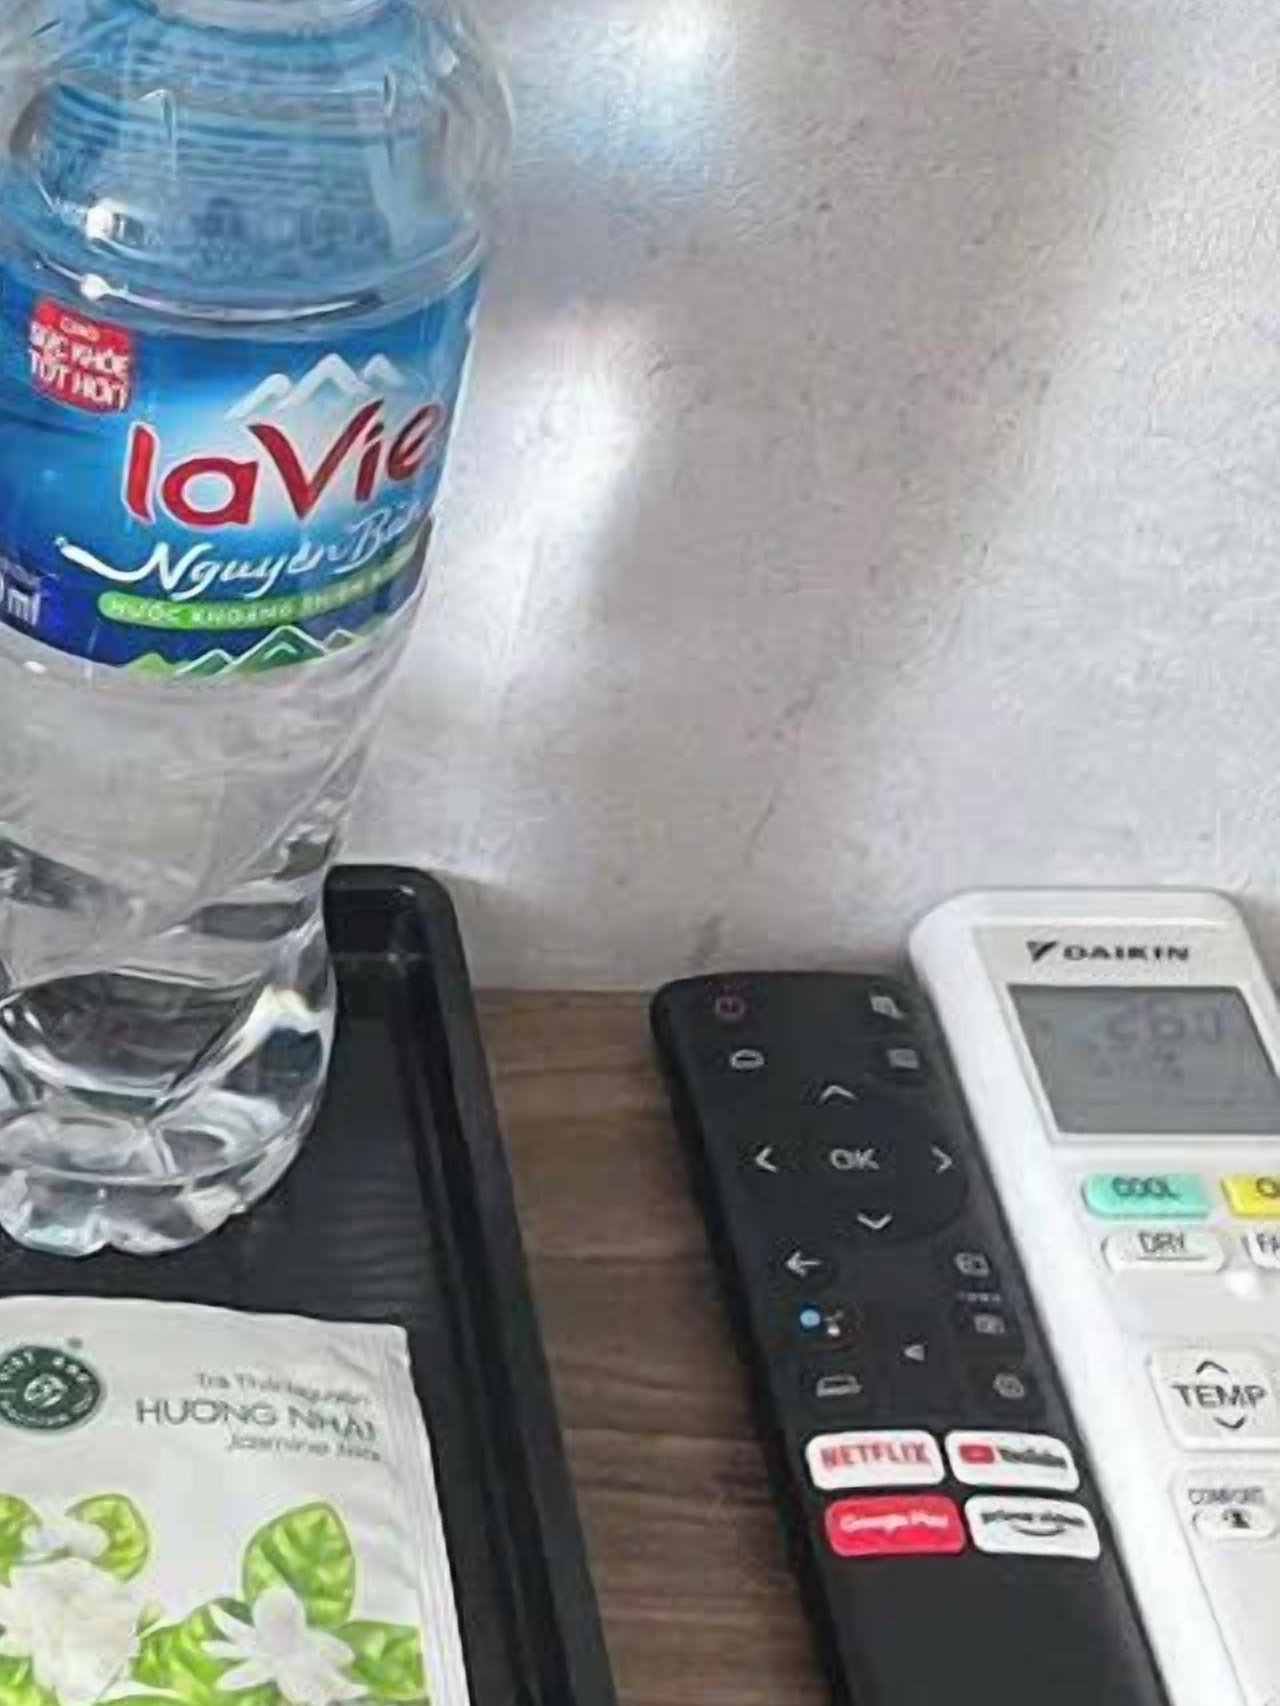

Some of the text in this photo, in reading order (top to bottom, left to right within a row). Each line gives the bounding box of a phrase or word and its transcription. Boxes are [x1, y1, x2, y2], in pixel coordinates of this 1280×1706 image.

[1064, 945, 1190, 961] DAIKIN
[829, 1148, 881, 1172] OK
[820, 1442, 931, 1470] NETFLIX
